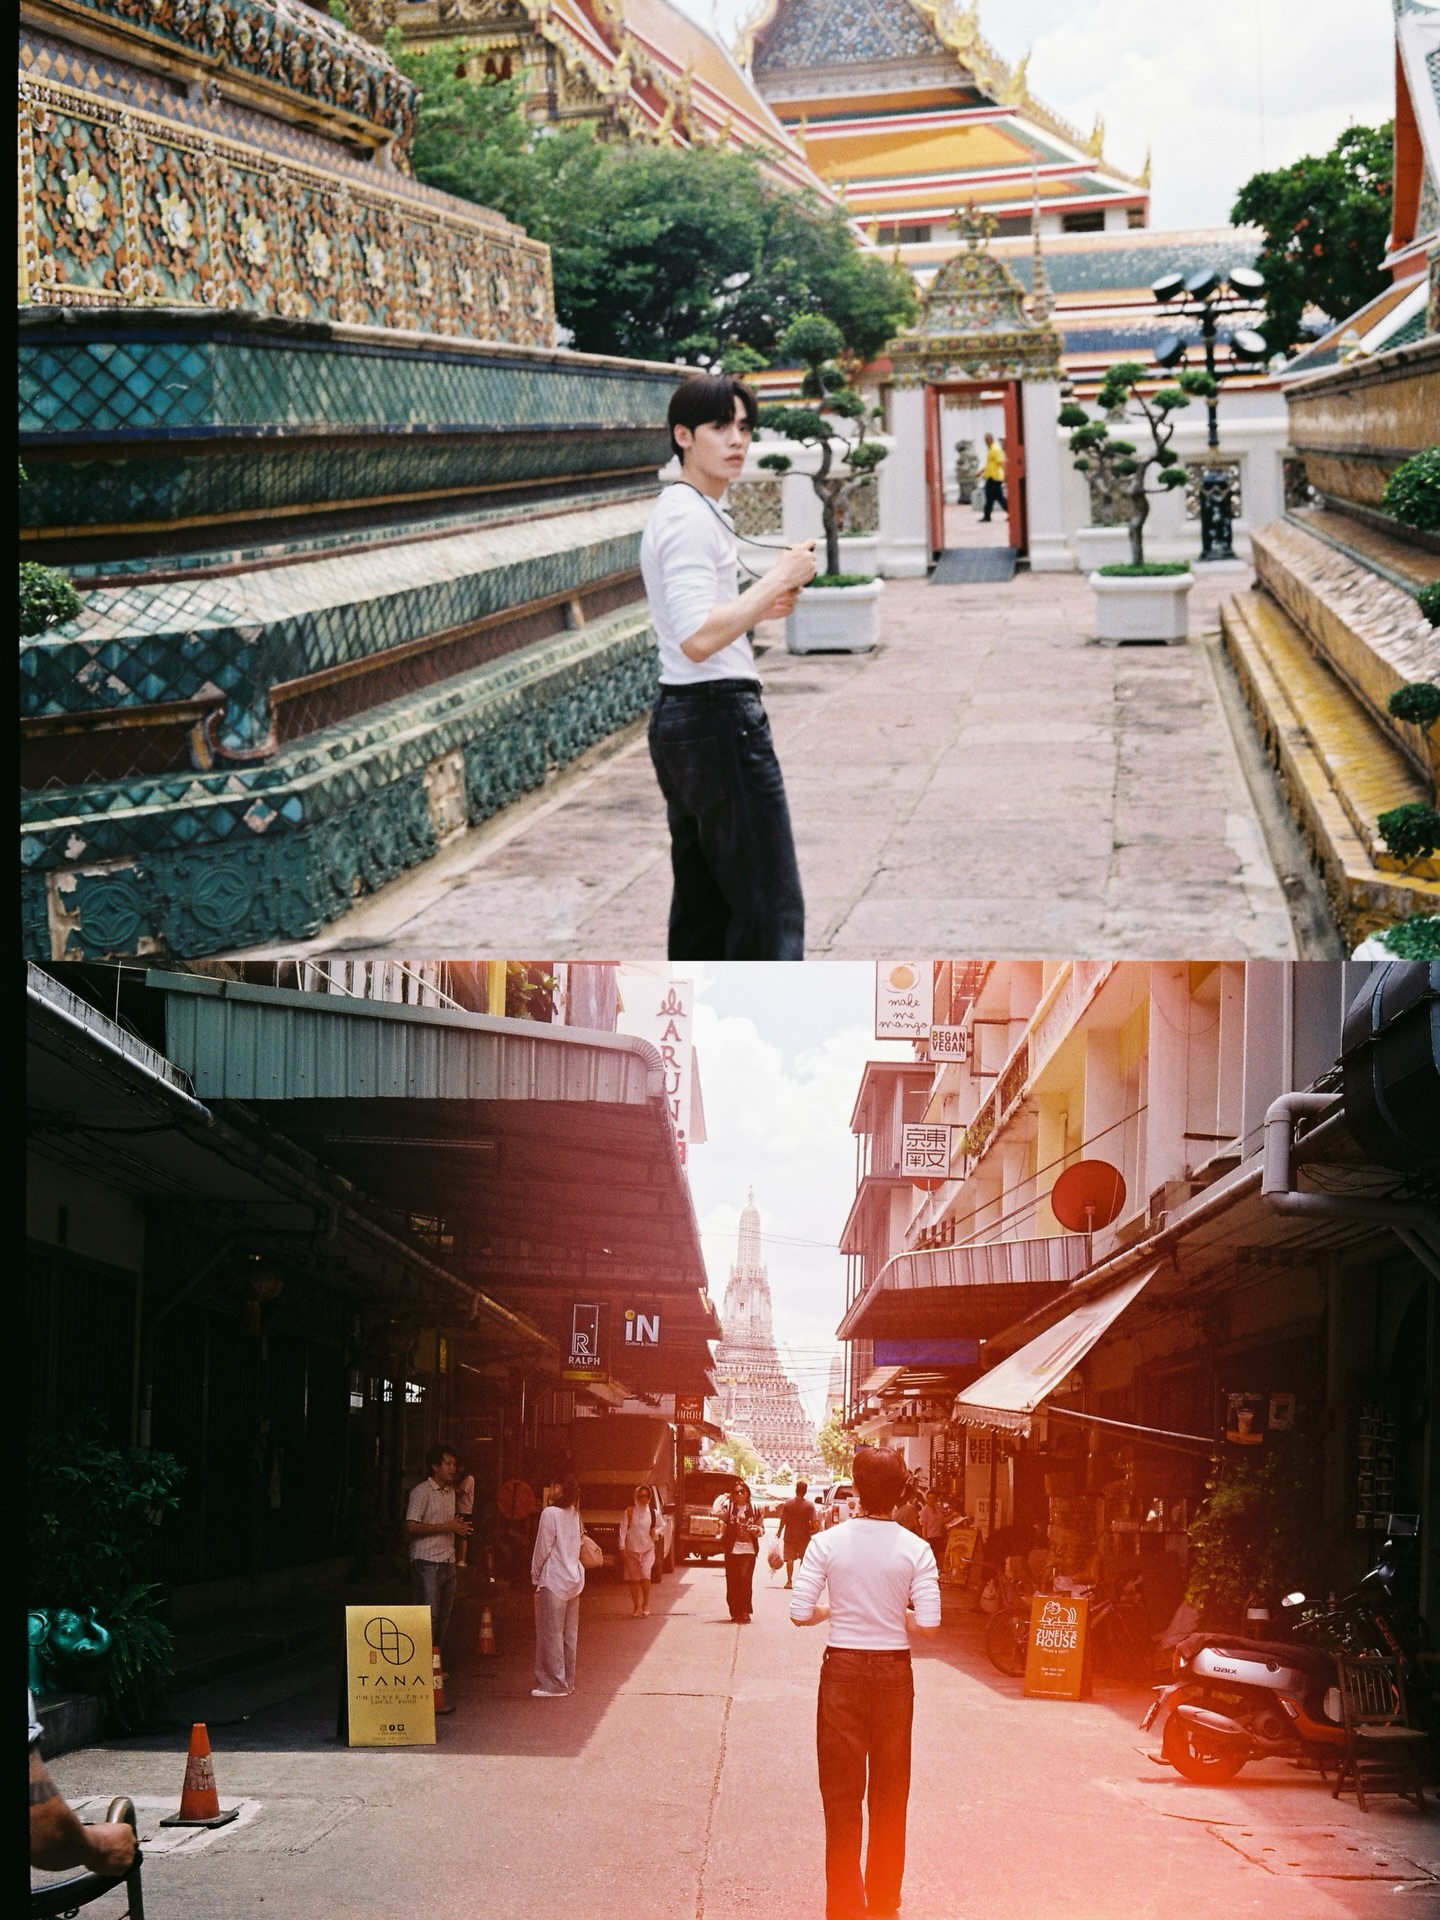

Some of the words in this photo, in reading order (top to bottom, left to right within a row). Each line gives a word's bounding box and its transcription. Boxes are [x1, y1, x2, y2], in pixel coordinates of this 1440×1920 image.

[888, 993, 920, 1008] make
[879, 1021, 928, 1036] mango
[932, 1031, 966, 1042] BEGAN
[932, 1041, 965, 1052] VEGAN
[625, 1309, 660, 1343] iN
[568, 1356, 600, 1365] RALPH
[1036, 1636, 1077, 1649] HOUSE
[357, 1676, 425, 1686] TANA
